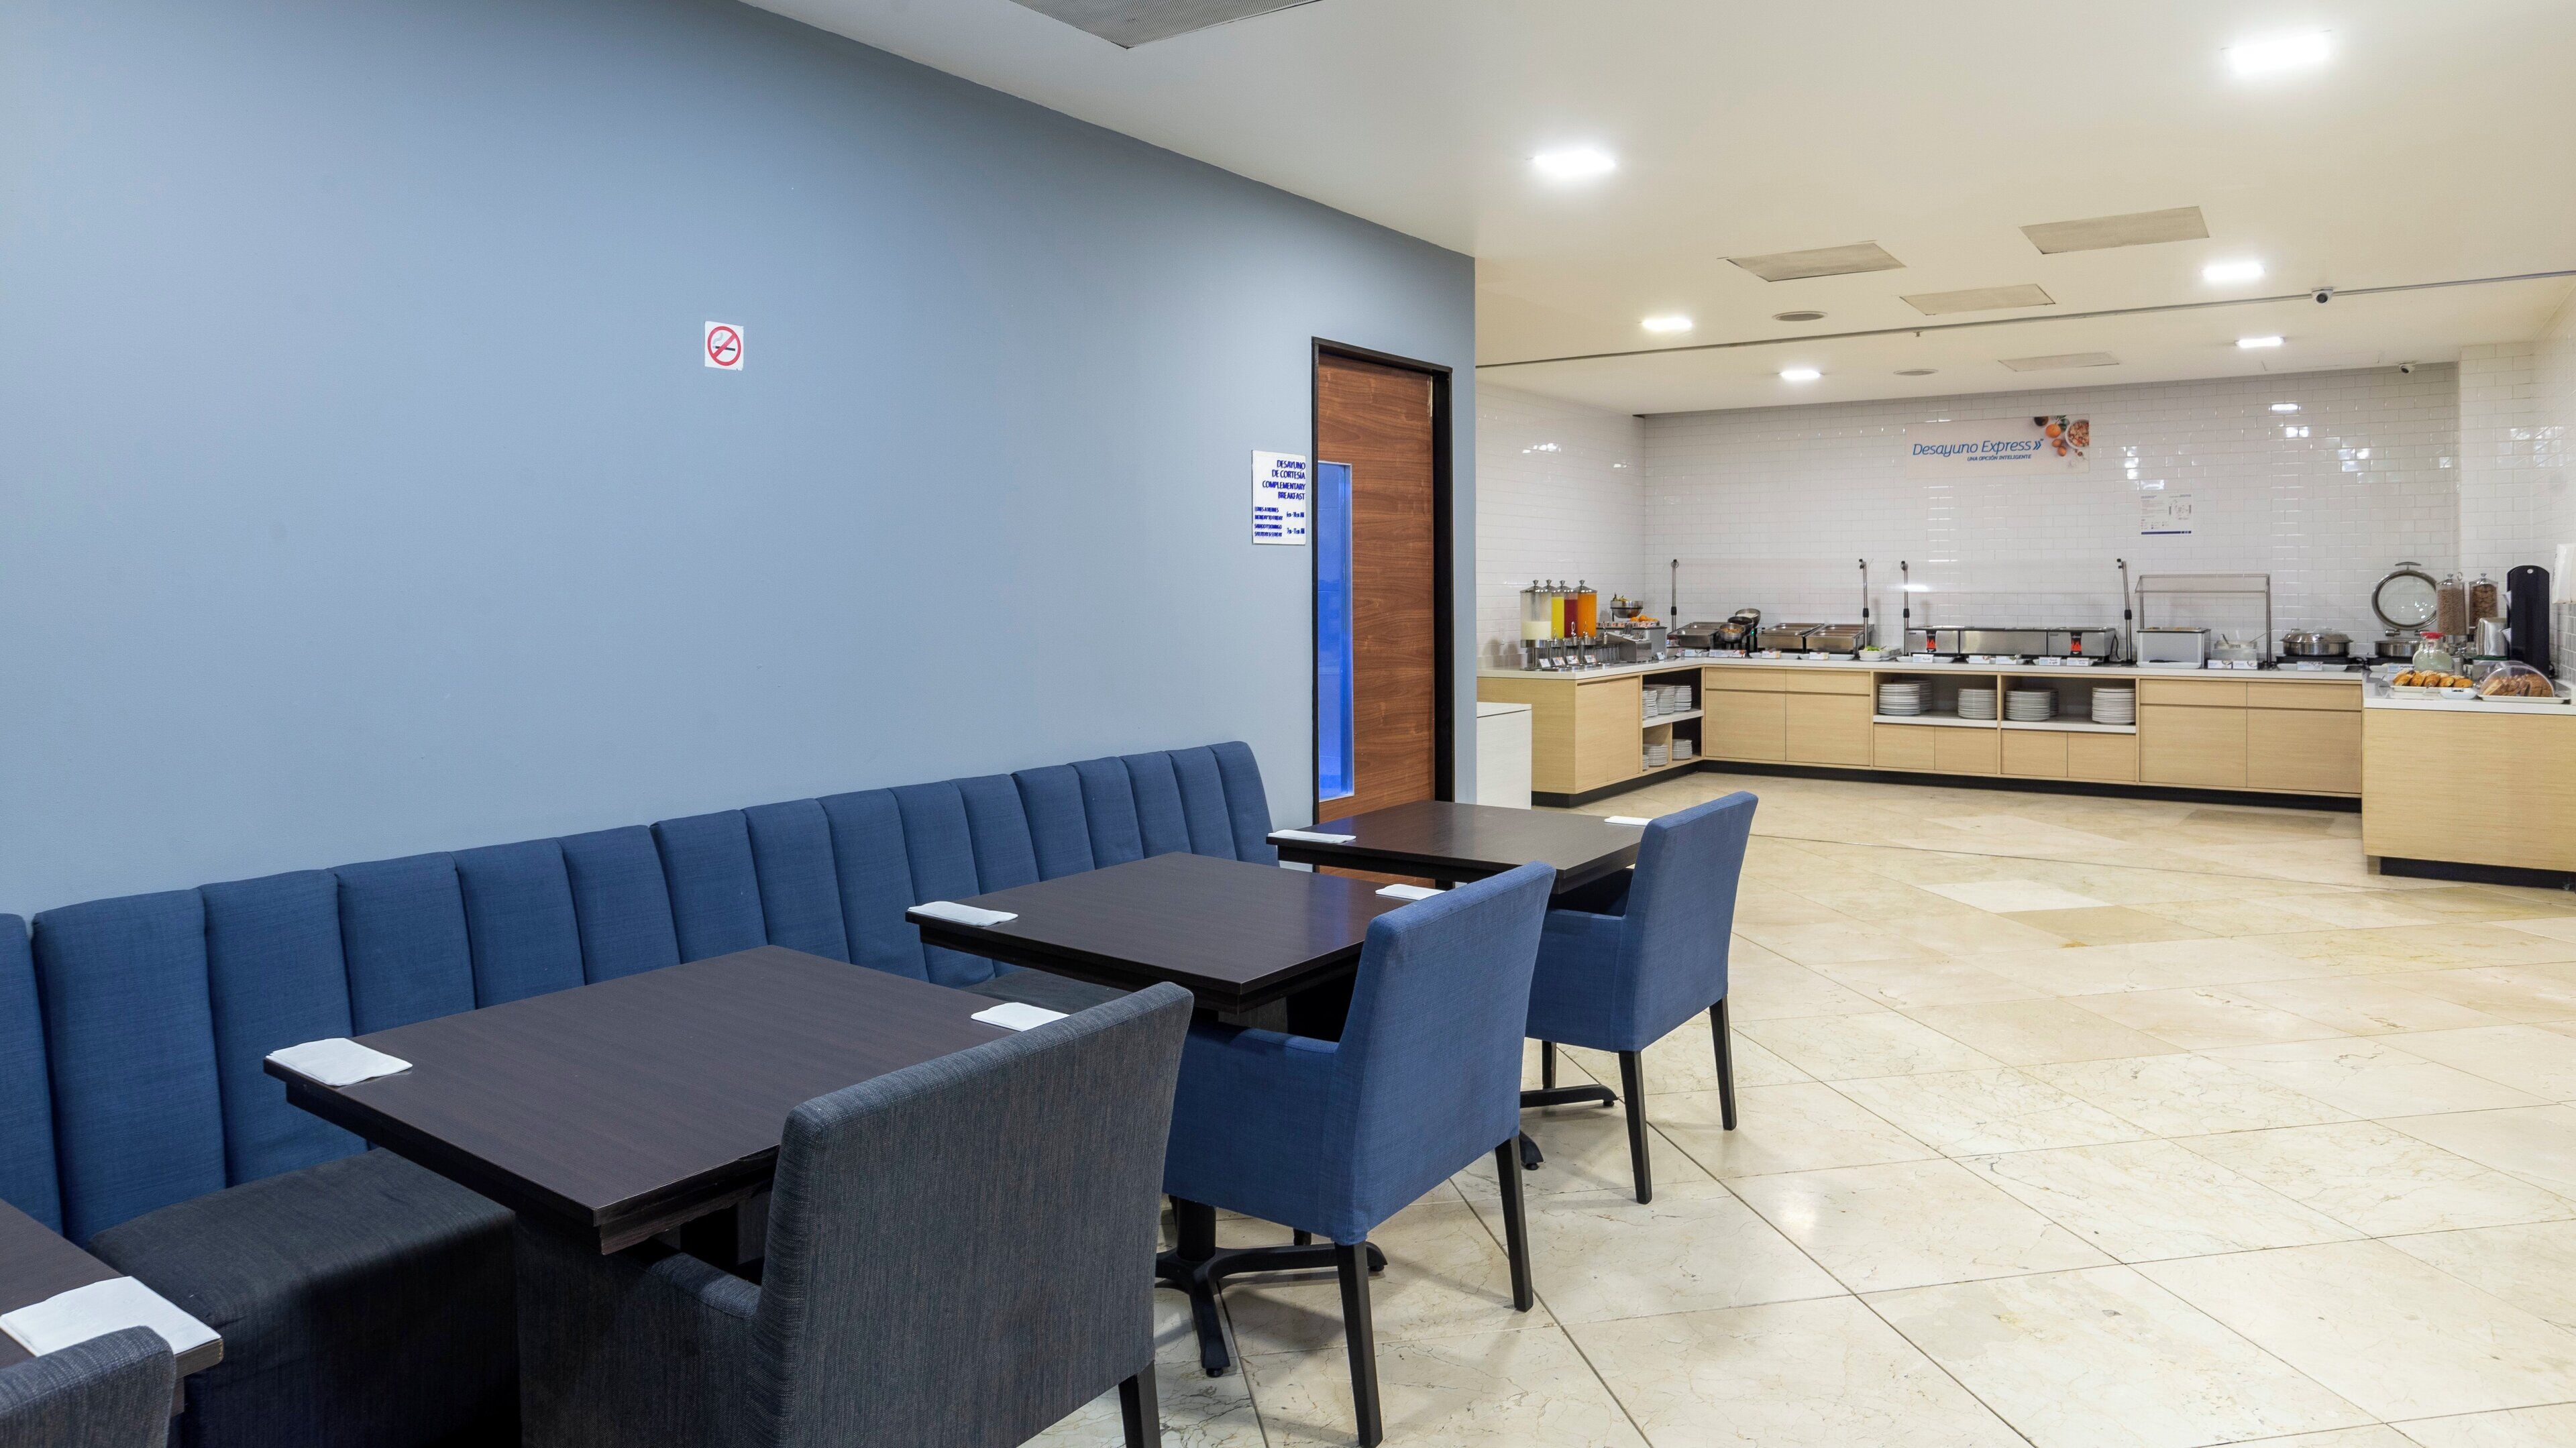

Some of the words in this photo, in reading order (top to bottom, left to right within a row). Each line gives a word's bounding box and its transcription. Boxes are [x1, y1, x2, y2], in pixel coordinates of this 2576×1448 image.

[1913, 442, 1978, 457] Desayuno
[1982, 440, 2031, 455] Express
[1277, 459, 1305, 470] DESAYUNO
[1272, 469, 1279, 478] DE
[1280, 469, 1305, 480] CORTESÍA
[1262, 480, 1305, 490] COMPLEMENTARY
[1278, 491, 1305, 500] BREAKFAST
